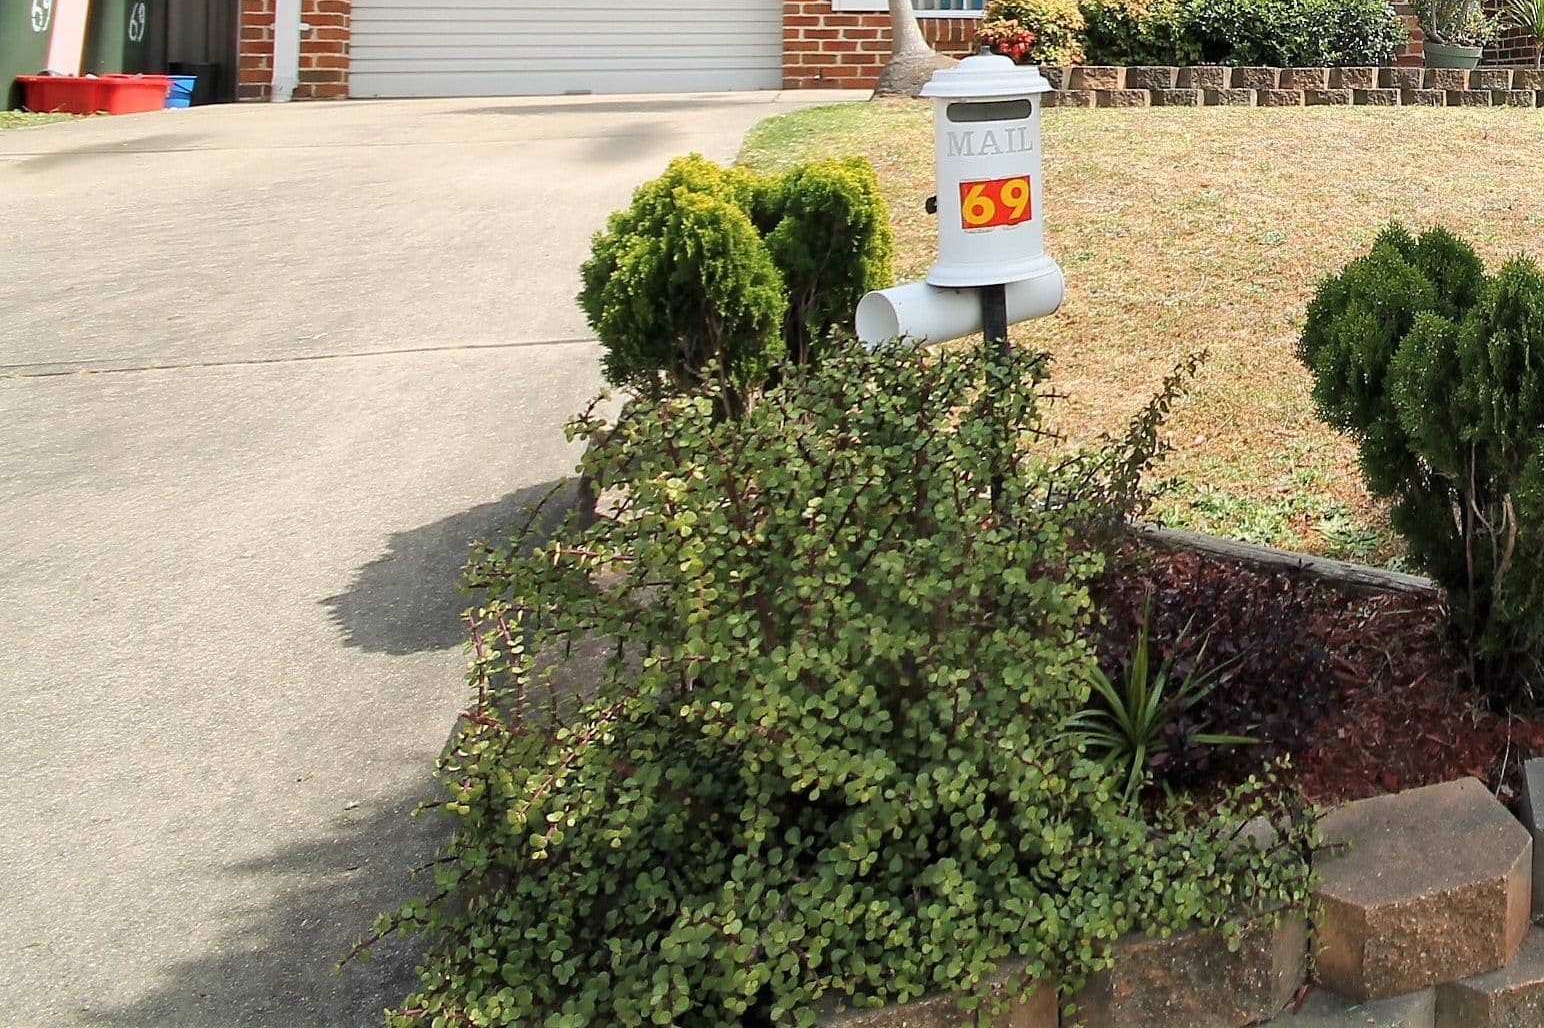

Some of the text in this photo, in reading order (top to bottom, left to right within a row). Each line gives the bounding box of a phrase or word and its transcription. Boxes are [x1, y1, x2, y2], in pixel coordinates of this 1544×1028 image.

[128, 2, 146, 42] 69
[946, 127, 1033, 157] MAIL
[962, 179, 1029, 225] 69
